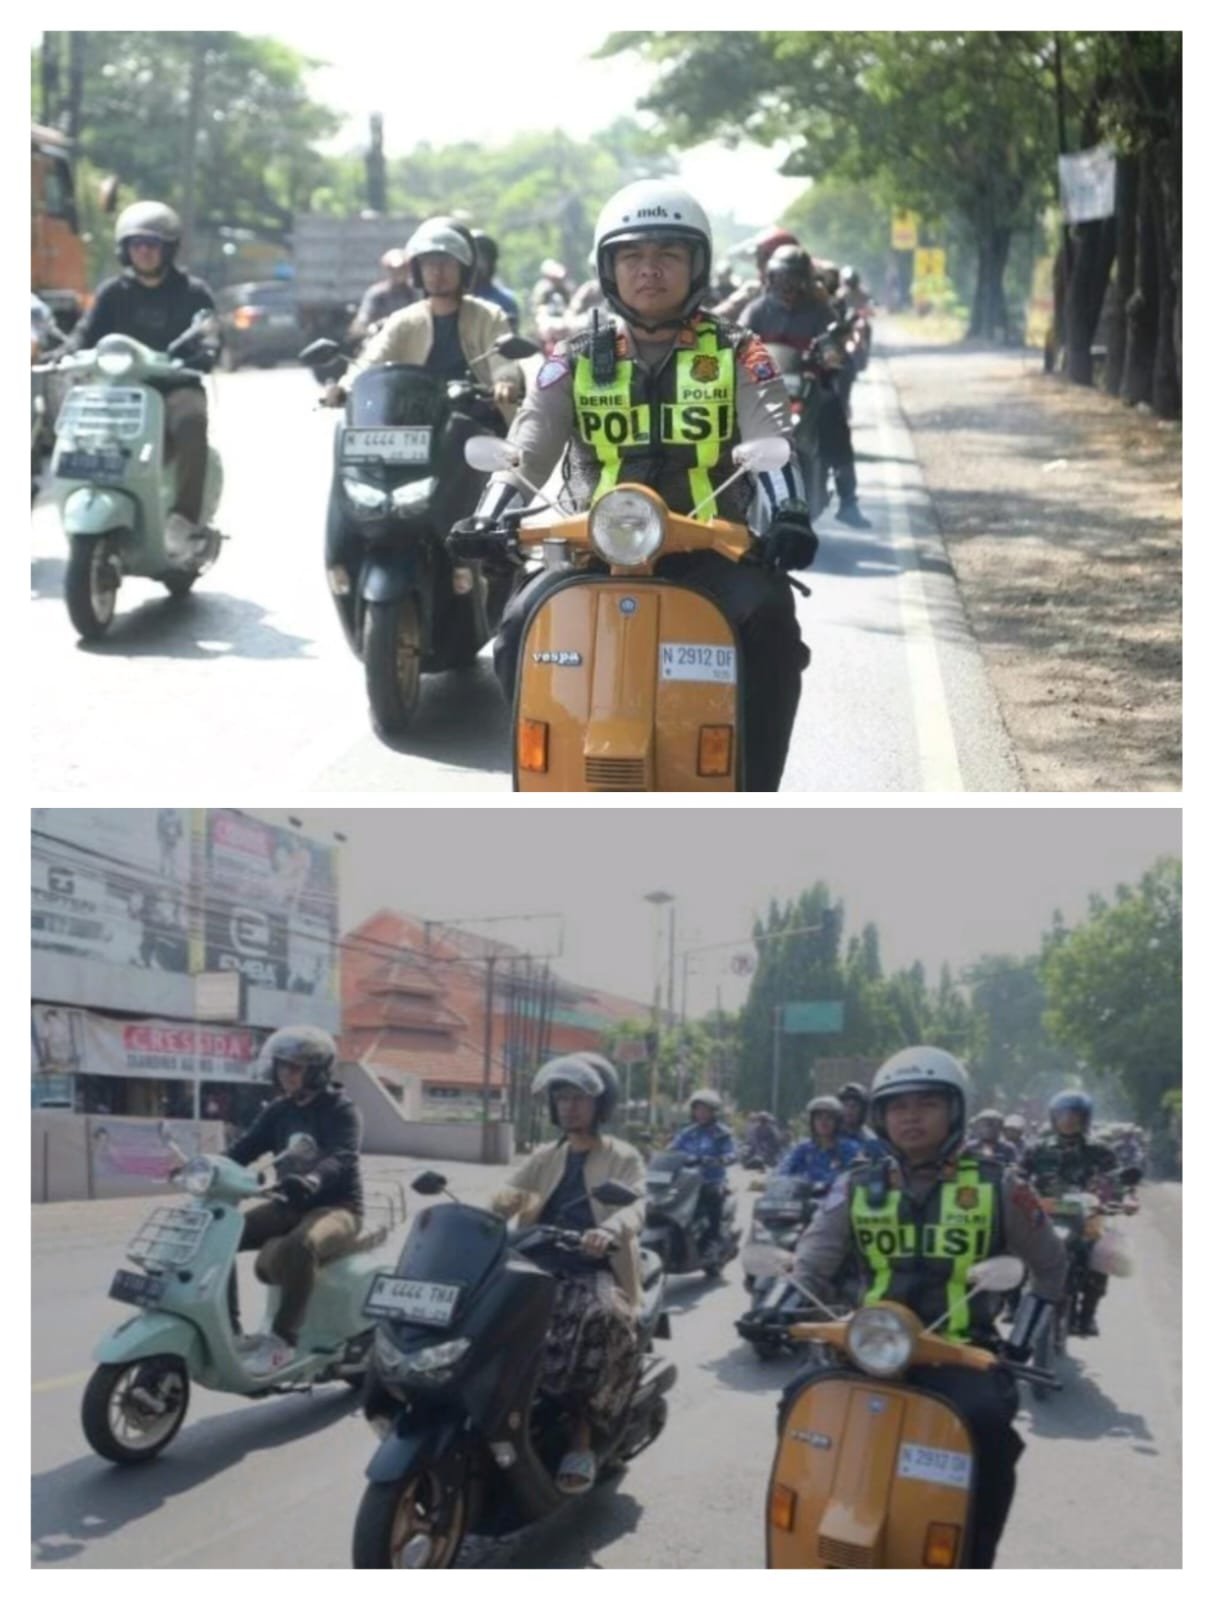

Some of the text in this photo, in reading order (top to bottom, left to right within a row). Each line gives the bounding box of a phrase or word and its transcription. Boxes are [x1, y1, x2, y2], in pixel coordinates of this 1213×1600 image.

[637, 205, 668, 218] mds
[579, 395, 625, 406] DERIE
[683, 388, 729, 400] POLRI
[531, 650, 582, 666] vespa
[663, 647, 673, 665] N
[678, 647, 713, 666] 2912
